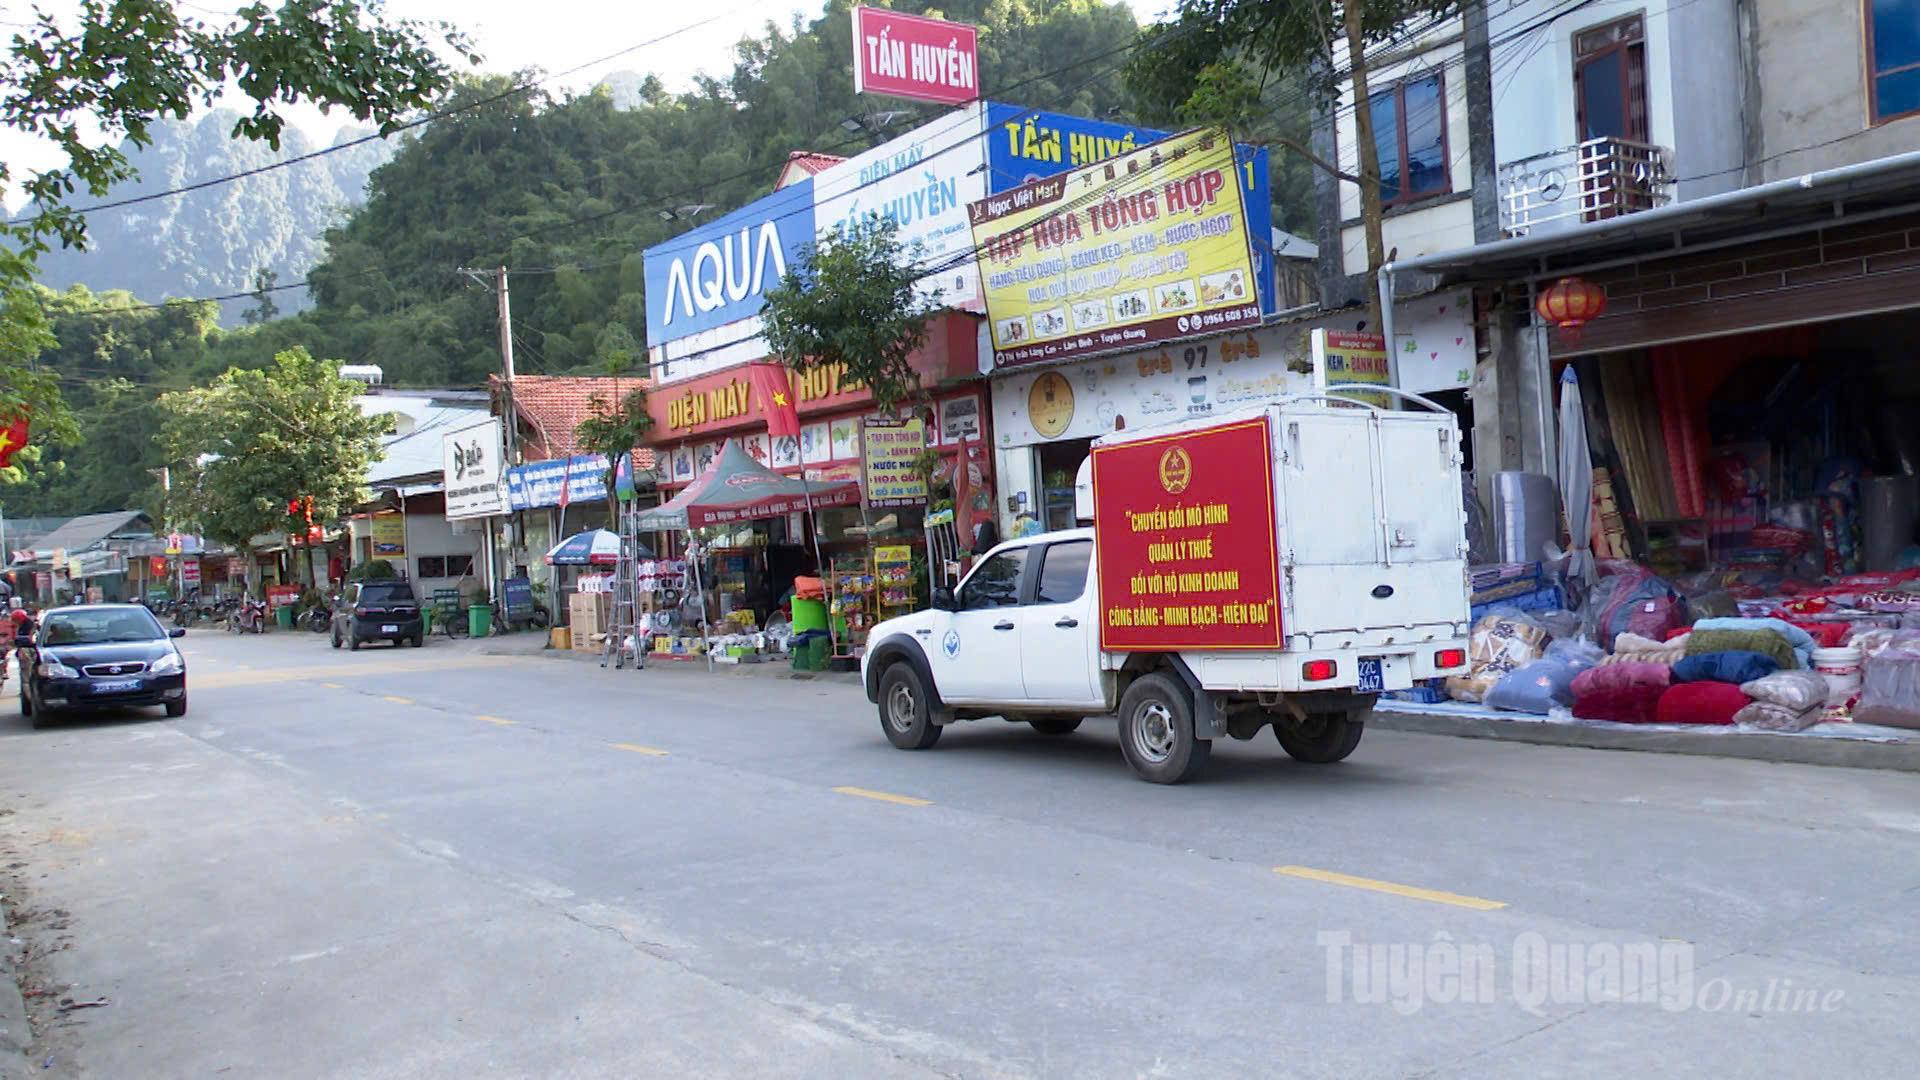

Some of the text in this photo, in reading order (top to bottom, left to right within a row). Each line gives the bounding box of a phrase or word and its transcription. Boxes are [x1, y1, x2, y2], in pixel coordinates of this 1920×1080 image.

[866, 25, 906, 79] TẤN
[1005, 114, 1062, 163] TẤN
[883, 170, 957, 226] HUYỀN
[988, 181, 1060, 217] Ngọc Việt Mart
[1164, 169, 1225, 214] HỢP
[1200, 214, 1233, 237] NGỌT
[664, 219, 786, 326] AQUA
[1184, 345, 1208, 370] 97
[711, 378, 751, 421] MÁY
[1168, 501, 1185, 528] ĐỔI
[1186, 501, 1202, 527] MÔ
[1203, 501, 1229, 525] HÌNH
[1148, 531, 1213, 563] QUẢN LÝ THUẾ
[1131, 569, 1239, 597] ĐỐI VỚI HỘ KINH DOANH
[1108, 604, 1132, 626] CÔNG
[1134, 599, 1158, 625] BẰNG
[1164, 606, 1189, 625] MINH
[1191, 605, 1217, 629] BẠCH
[1223, 600, 1248, 628] HIỆN
[1359, 661, 1377, 676] 22C
